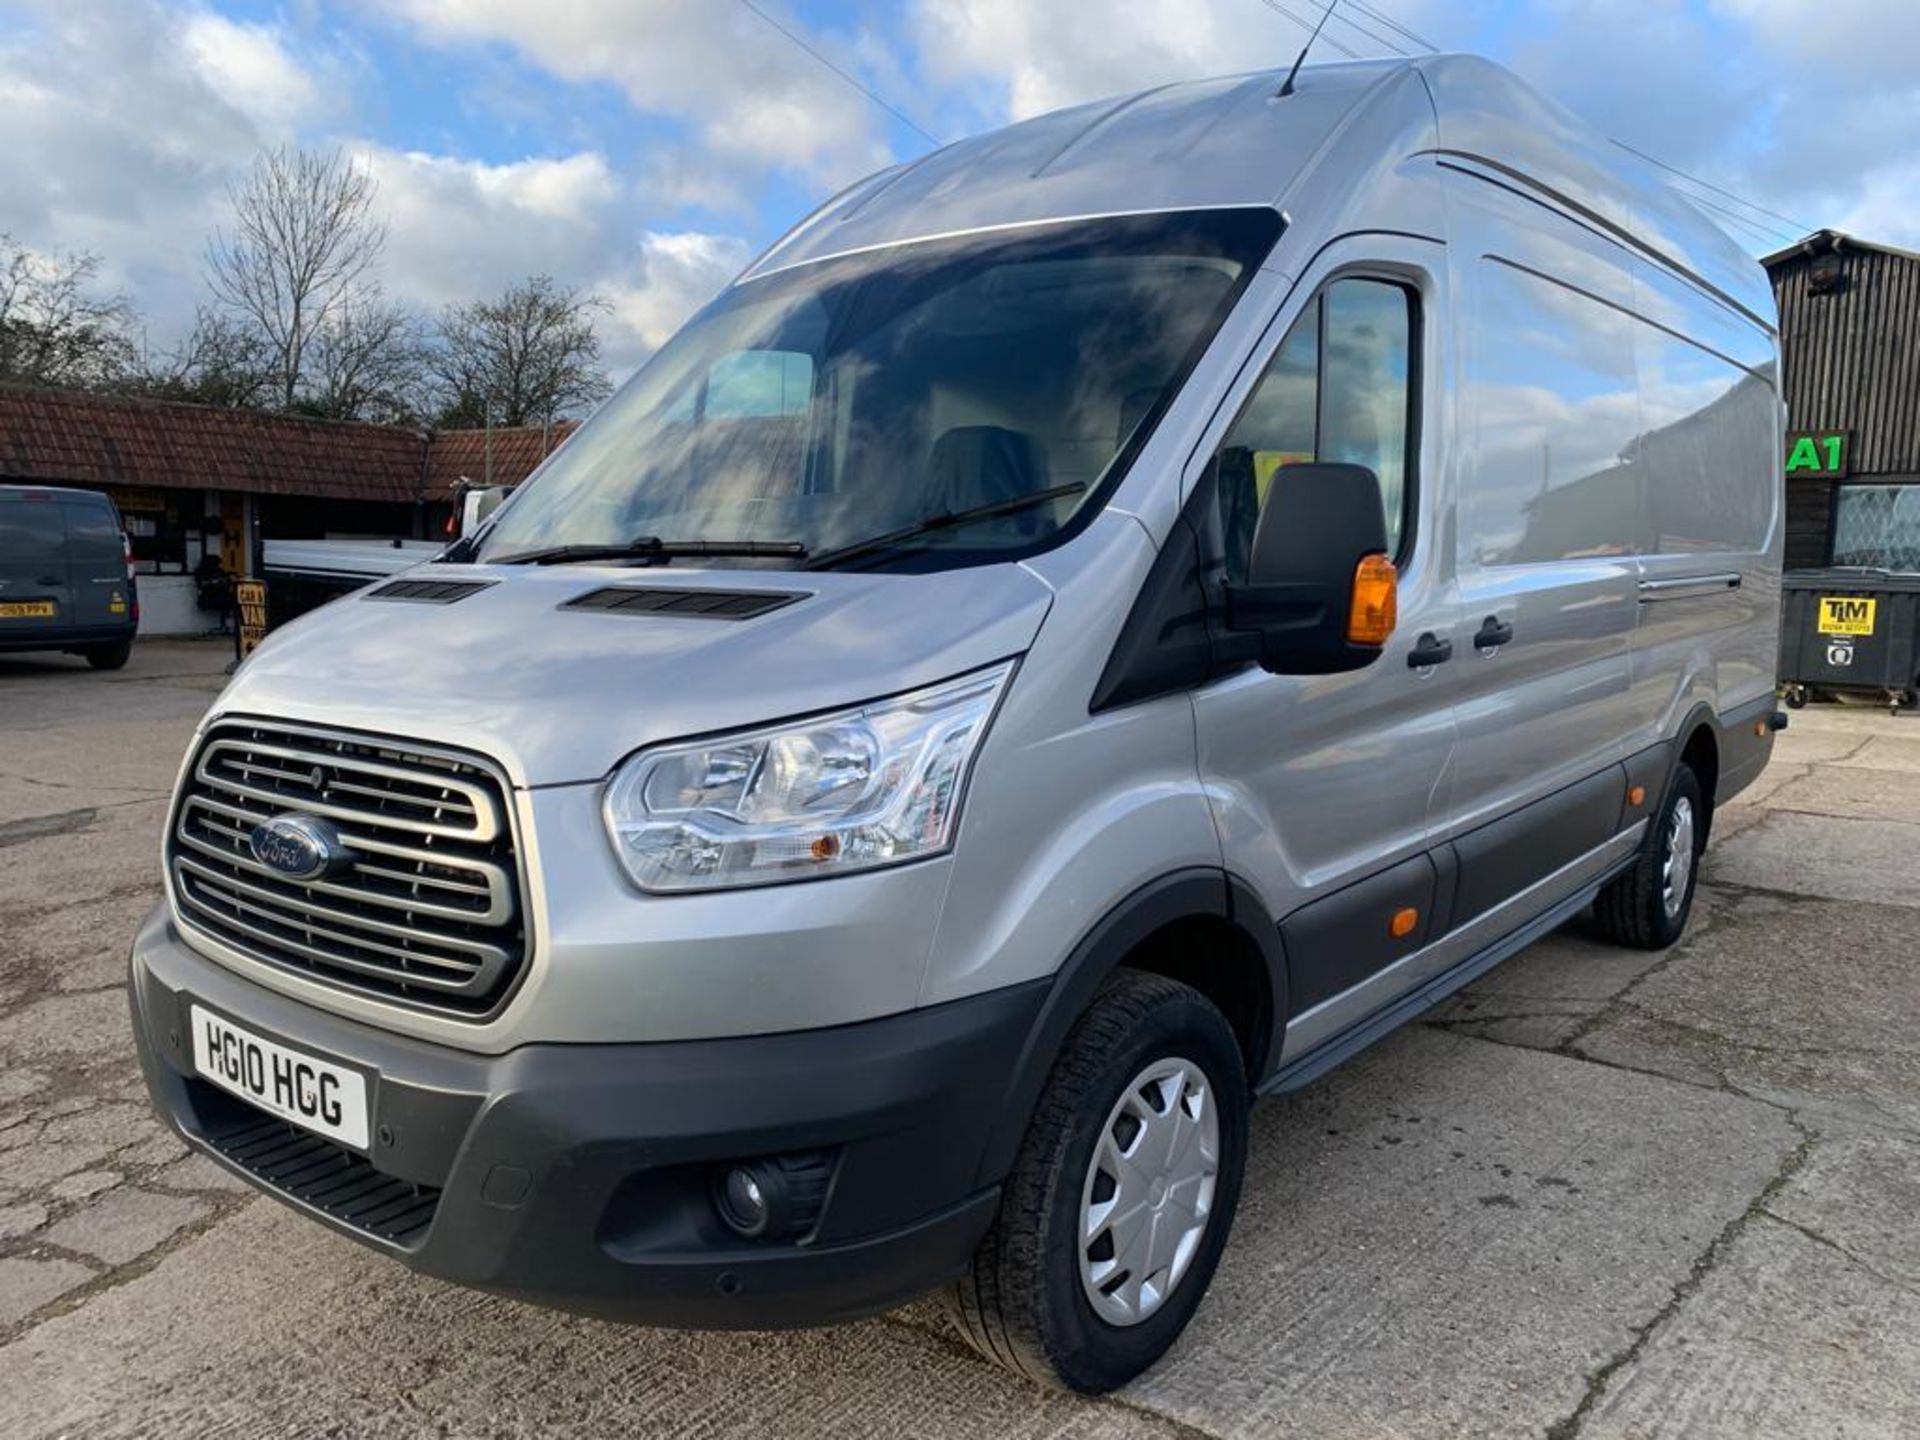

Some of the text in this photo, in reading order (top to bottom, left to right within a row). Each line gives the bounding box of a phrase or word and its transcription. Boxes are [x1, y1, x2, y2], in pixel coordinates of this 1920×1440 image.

[1786, 437, 1842, 471] A1
[240, 604, 265, 627] VAN
[207, 1021, 342, 1127] HG10 HGG
